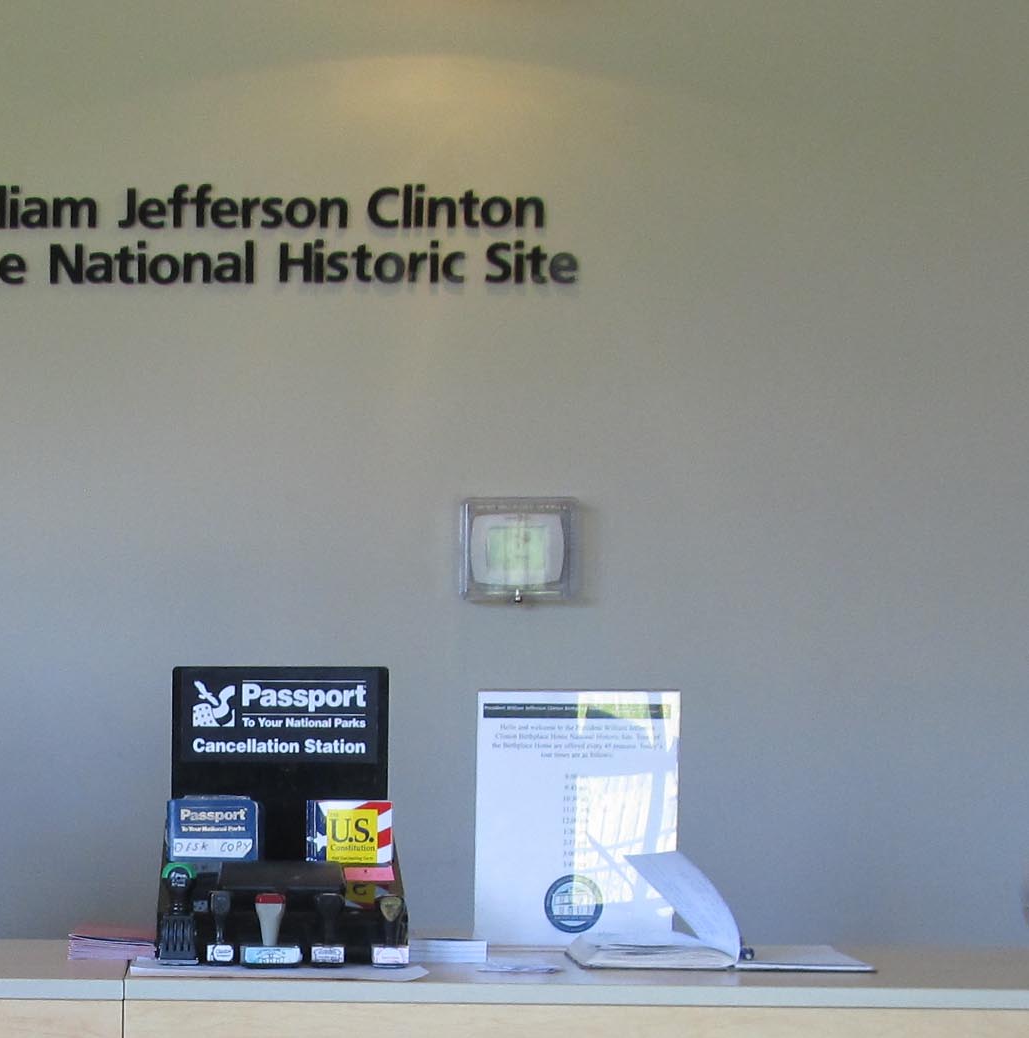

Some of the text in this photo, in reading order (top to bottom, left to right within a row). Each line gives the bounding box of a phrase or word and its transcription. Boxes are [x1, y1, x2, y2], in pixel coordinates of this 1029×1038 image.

[118, 183, 348, 229] Jefferson
[367, 183, 545, 229] Clinton
[49, 240, 255, 285] National
[278, 239, 466, 283] Historic
[484, 239, 579, 283] Site
[242, 683, 366, 712] Passport
[242, 717, 366, 728] To Your National Parks
[192, 738, 366, 754] Cancellation Station
[180, 807, 246, 823] Passport
[329, 817, 375, 843] U.S.
[219, 840, 251, 853] COPY
[330, 844, 376, 852] Constitution
